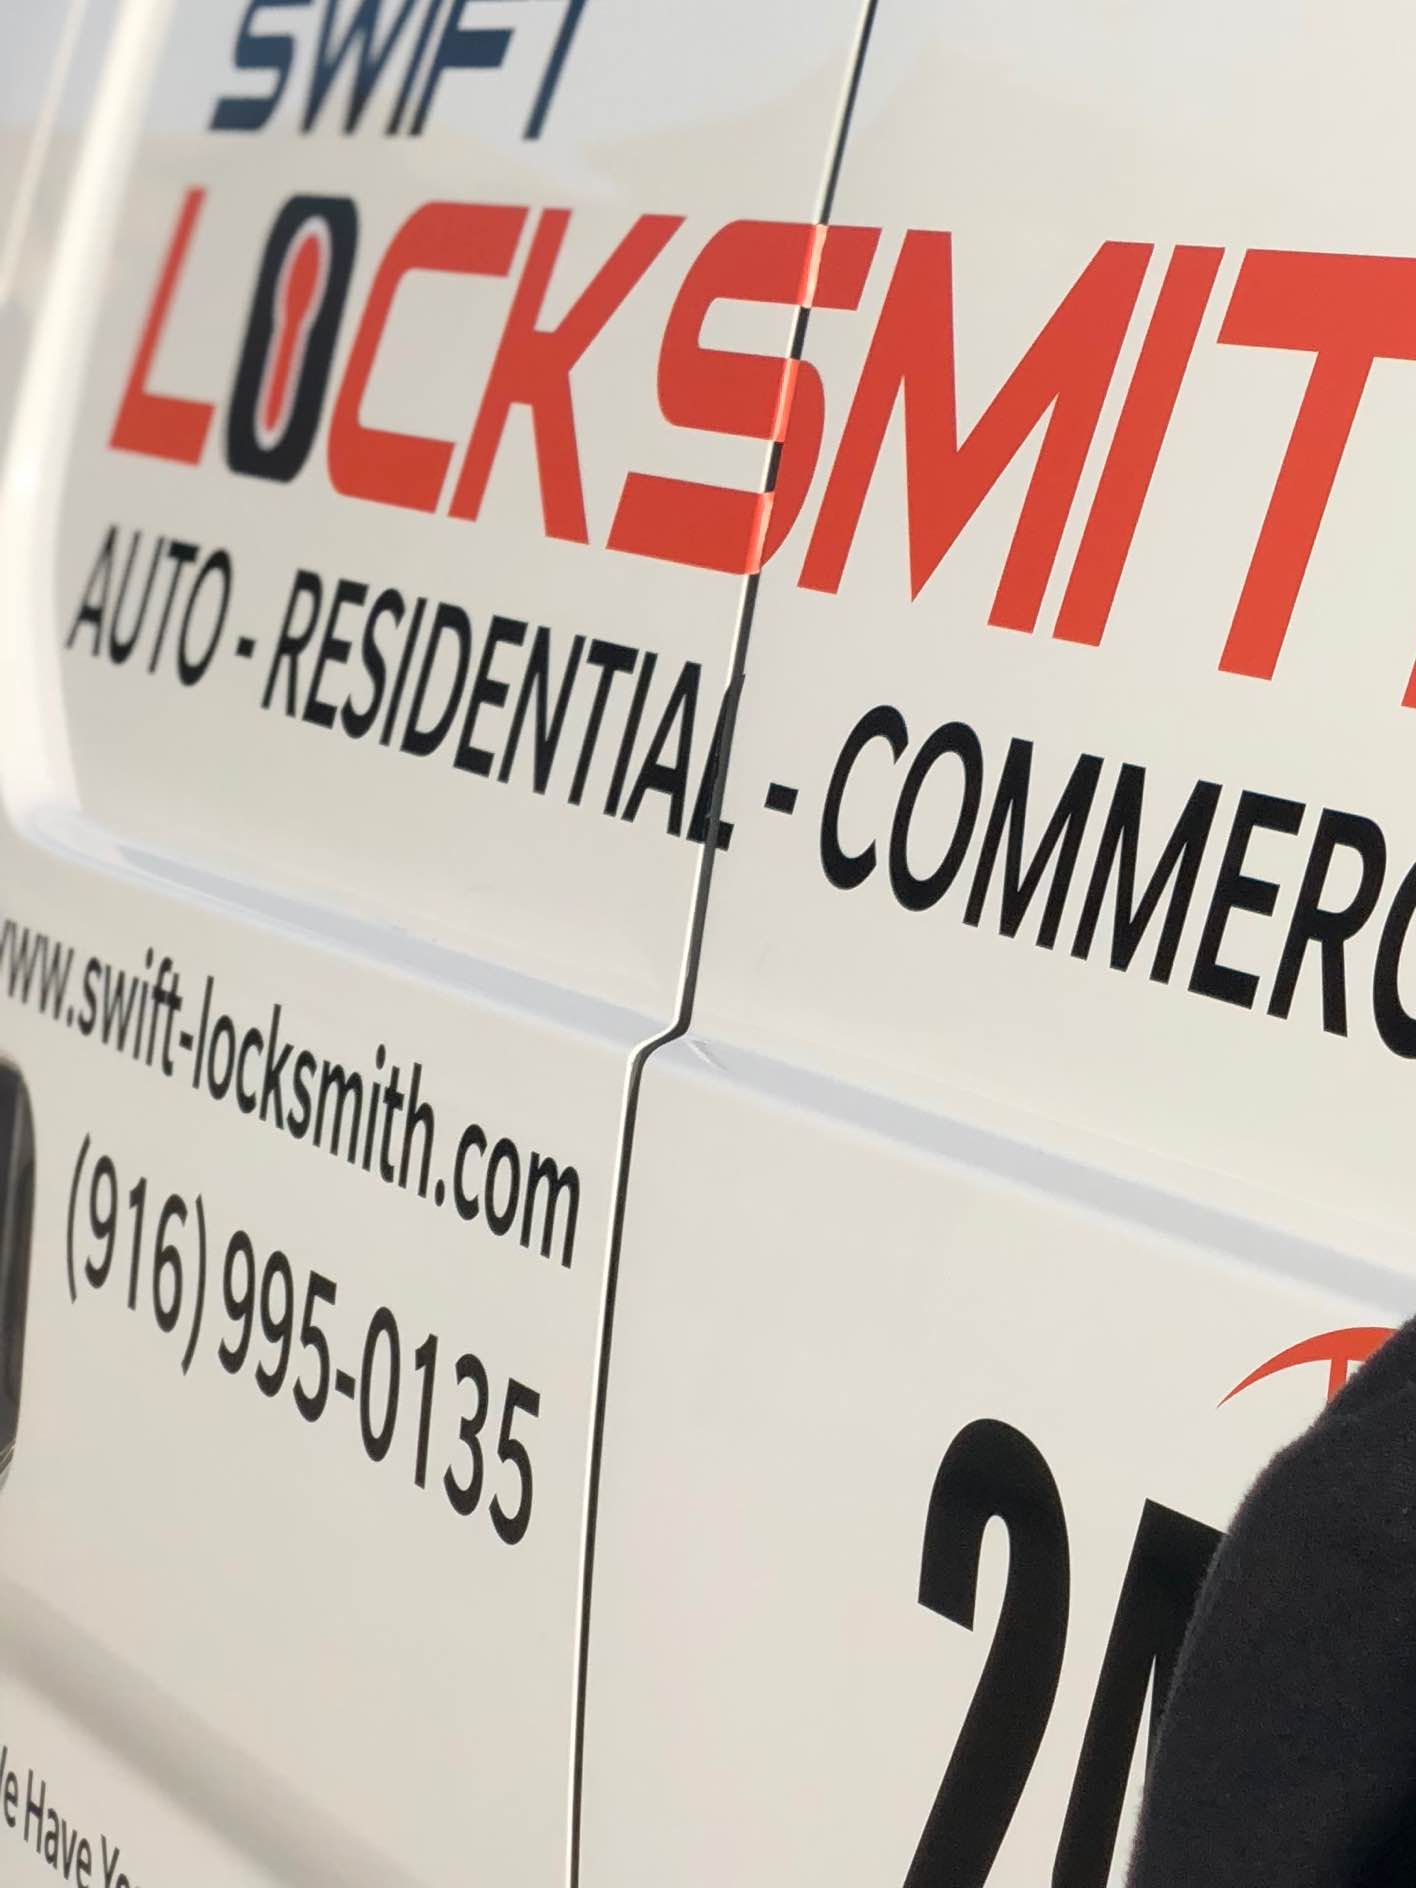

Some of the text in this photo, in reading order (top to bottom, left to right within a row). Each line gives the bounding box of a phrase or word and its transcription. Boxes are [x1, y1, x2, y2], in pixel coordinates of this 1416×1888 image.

[65, 523, 233, 687] AUTO
[260, 567, 744, 853] RESIDENTIAL
[0, 918, 581, 1270] ww.swift-locksmith.com
[24, 1767, 92, 1888] Have
